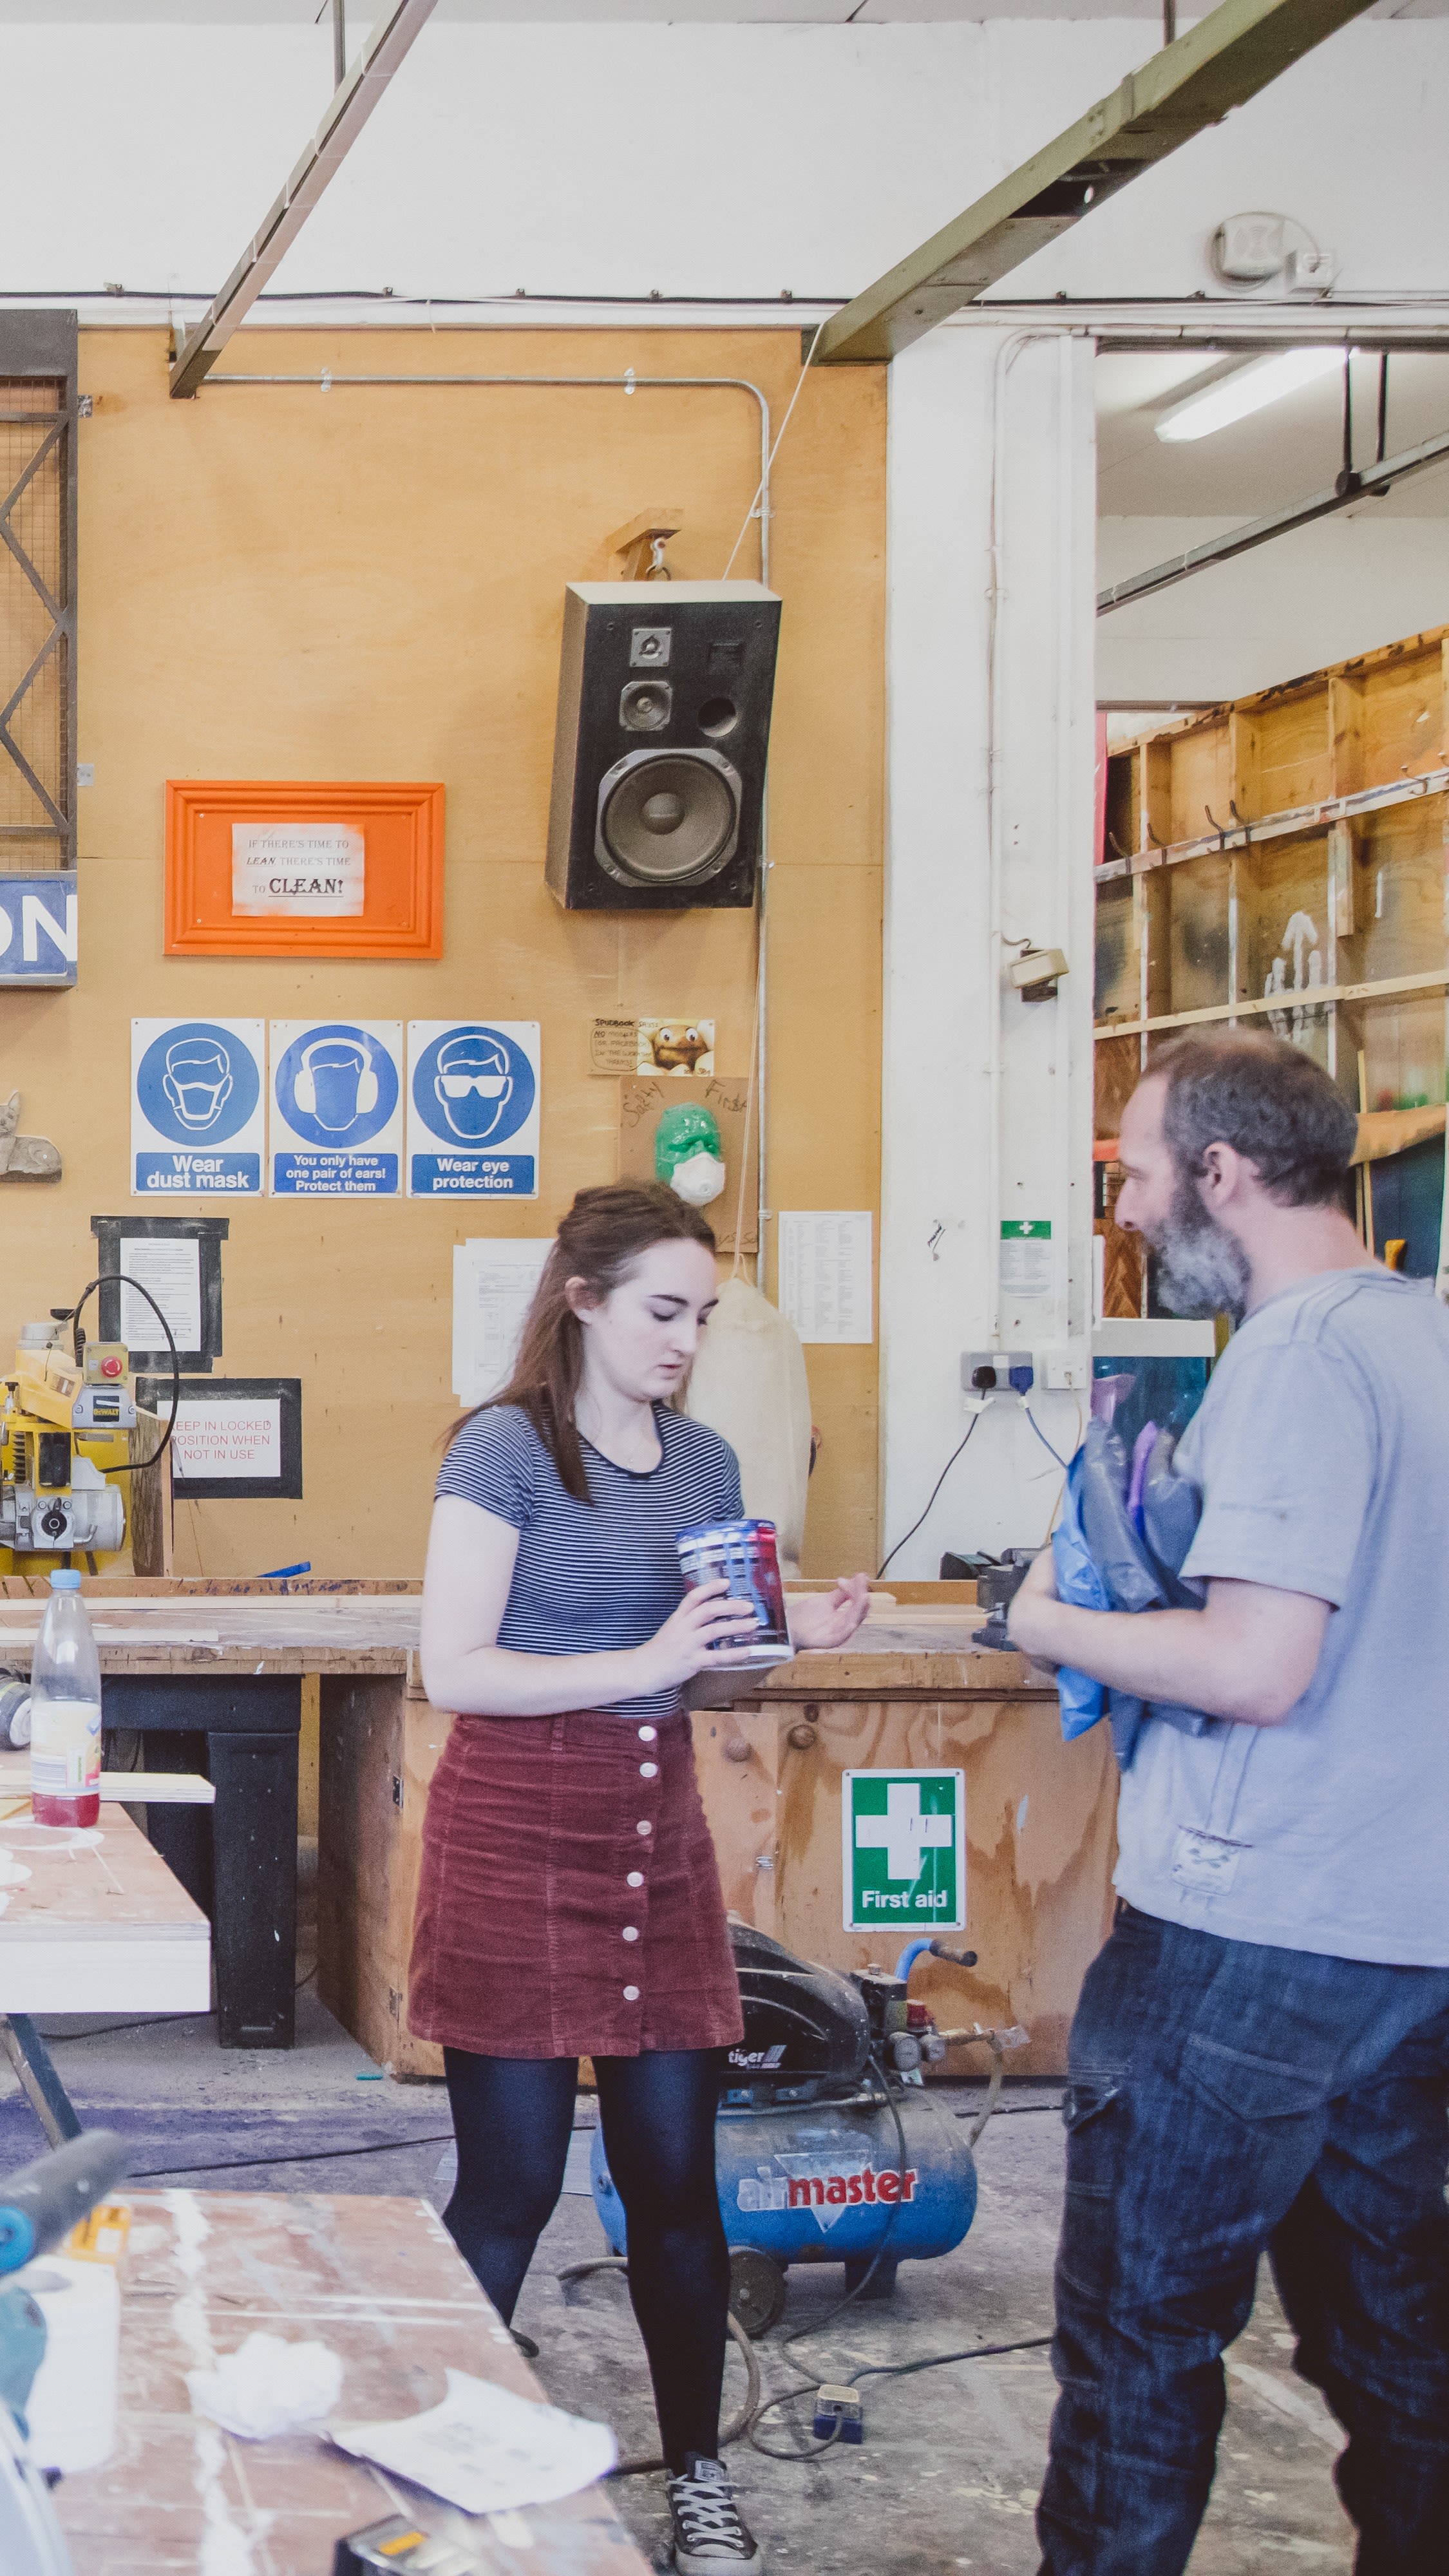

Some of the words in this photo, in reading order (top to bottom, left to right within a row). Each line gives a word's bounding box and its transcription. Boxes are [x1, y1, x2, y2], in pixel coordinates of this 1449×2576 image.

[249, 840, 258, 848] IF
[261, 840, 305, 848] THERE'S
[252, 886, 265, 894] TO
[269, 878, 344, 895] CLEAN!
[0, 895, 77, 961] N
[173, 1155, 223, 1172] Wear
[294, 1155, 317, 1166] You
[320, 1155, 345, 1168] only
[348, 1155, 379, 1166] have
[437, 1158, 478, 1172] Wear
[482, 1161, 509, 1175] eye
[147, 1171, 191, 1188] dust
[196, 1171, 249, 1188] mask
[286, 1170, 309, 1179] one
[312, 1168, 337, 1180] pair
[339, 1168, 352, 1179] of
[355, 1168, 386, 1179] ears!
[296, 1180, 341, 1191] Protect
[345, 1180, 376, 1191] them
[433, 1175, 513, 1190] protection
[172, 1421, 200, 1430] EEP
[205, 1421, 216, 1430] IN
[221, 1421, 271, 1430] LOCKED
[232, 1435, 270, 1445] WHEN
[184, 1450, 209, 1459] NOT
[214, 1450, 225, 1459] IN
[230, 1450, 255, 1459] USE
[862, 1889, 910, 1908] First
[914, 1889, 947, 1908] aid
[728, 2049, 765, 2067] tiger
